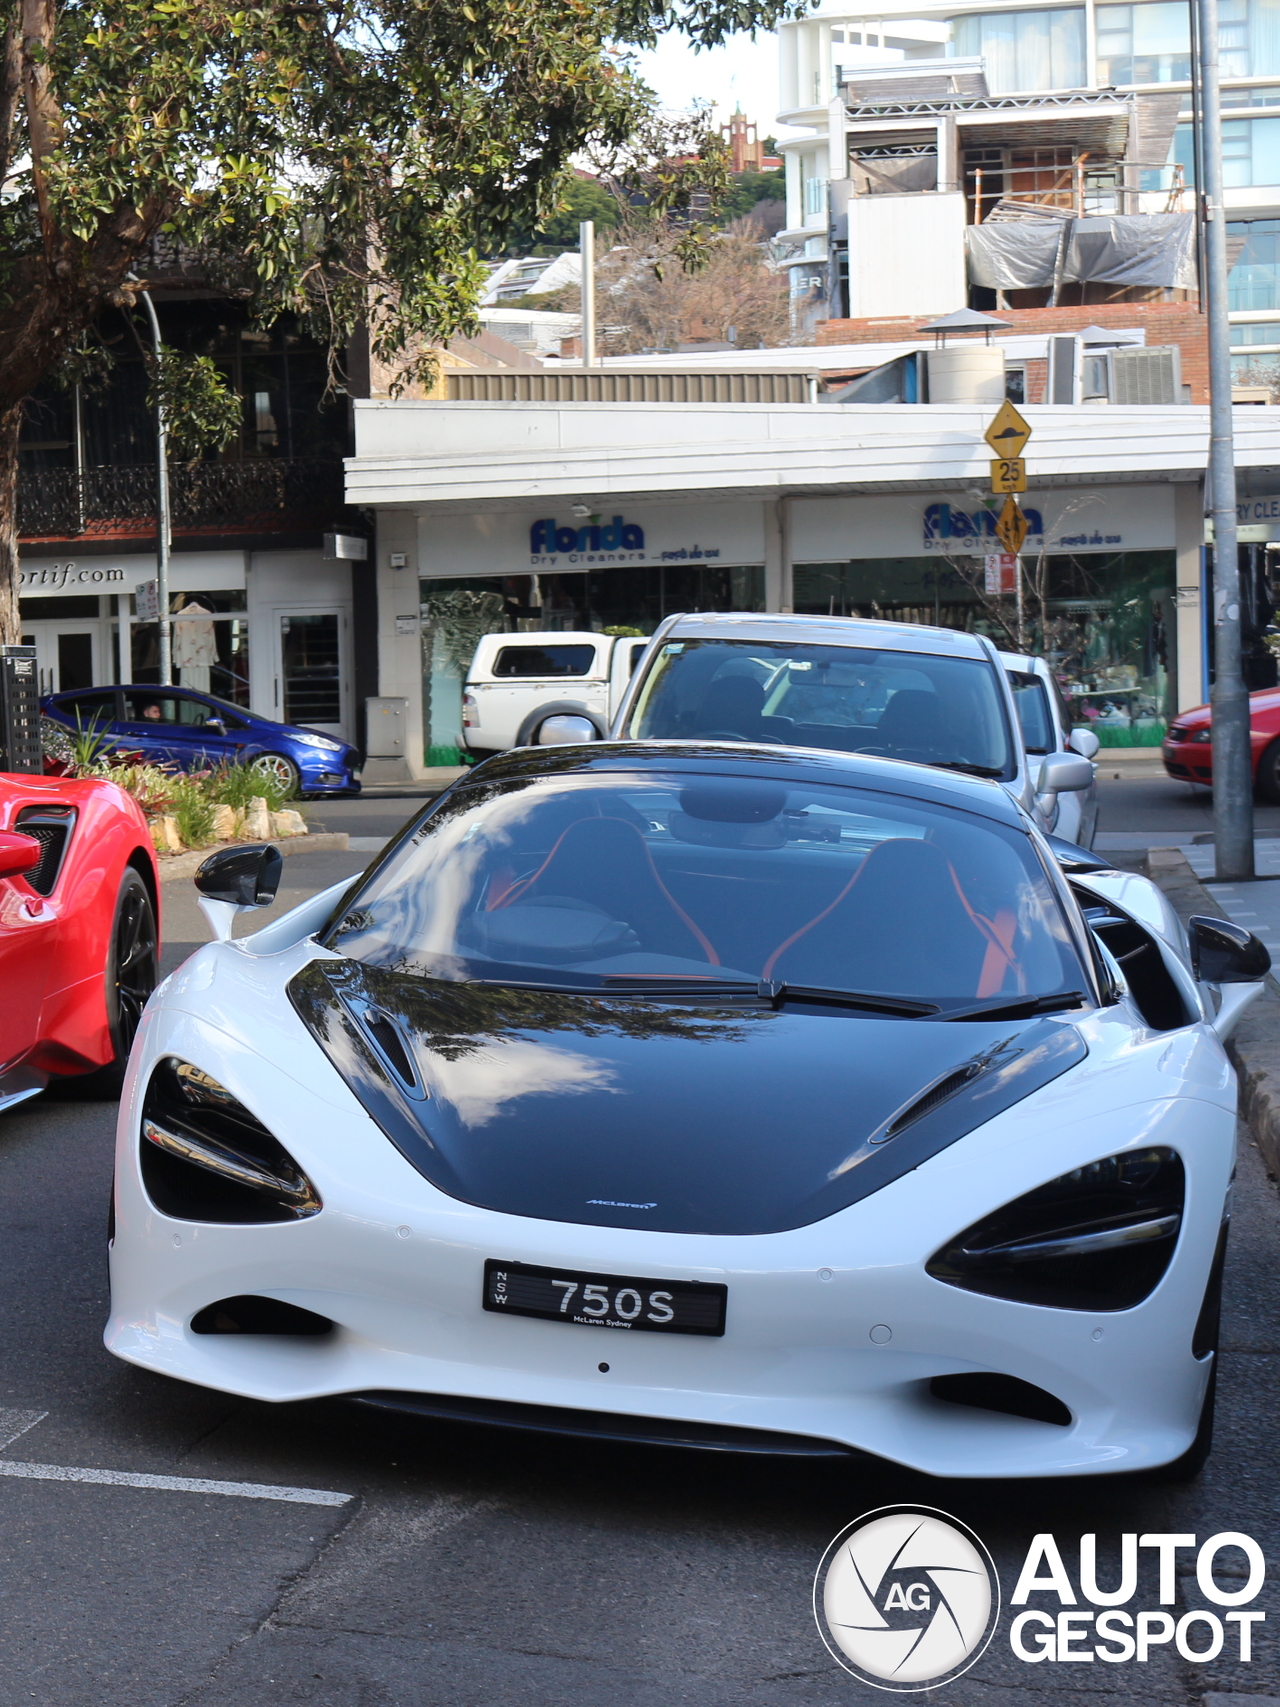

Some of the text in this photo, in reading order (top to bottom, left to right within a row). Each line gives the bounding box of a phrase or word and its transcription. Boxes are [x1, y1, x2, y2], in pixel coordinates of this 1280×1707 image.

[1000, 461, 1019, 482] 25
[1254, 501, 1280, 518] CLE
[924, 503, 1043, 540] floria
[531, 516, 644, 554] florida
[531, 551, 646, 565] Dry Cleaners
[551, 1279, 675, 1323] 750S
[573, 1315, 632, 1329] McLaren Sydney
